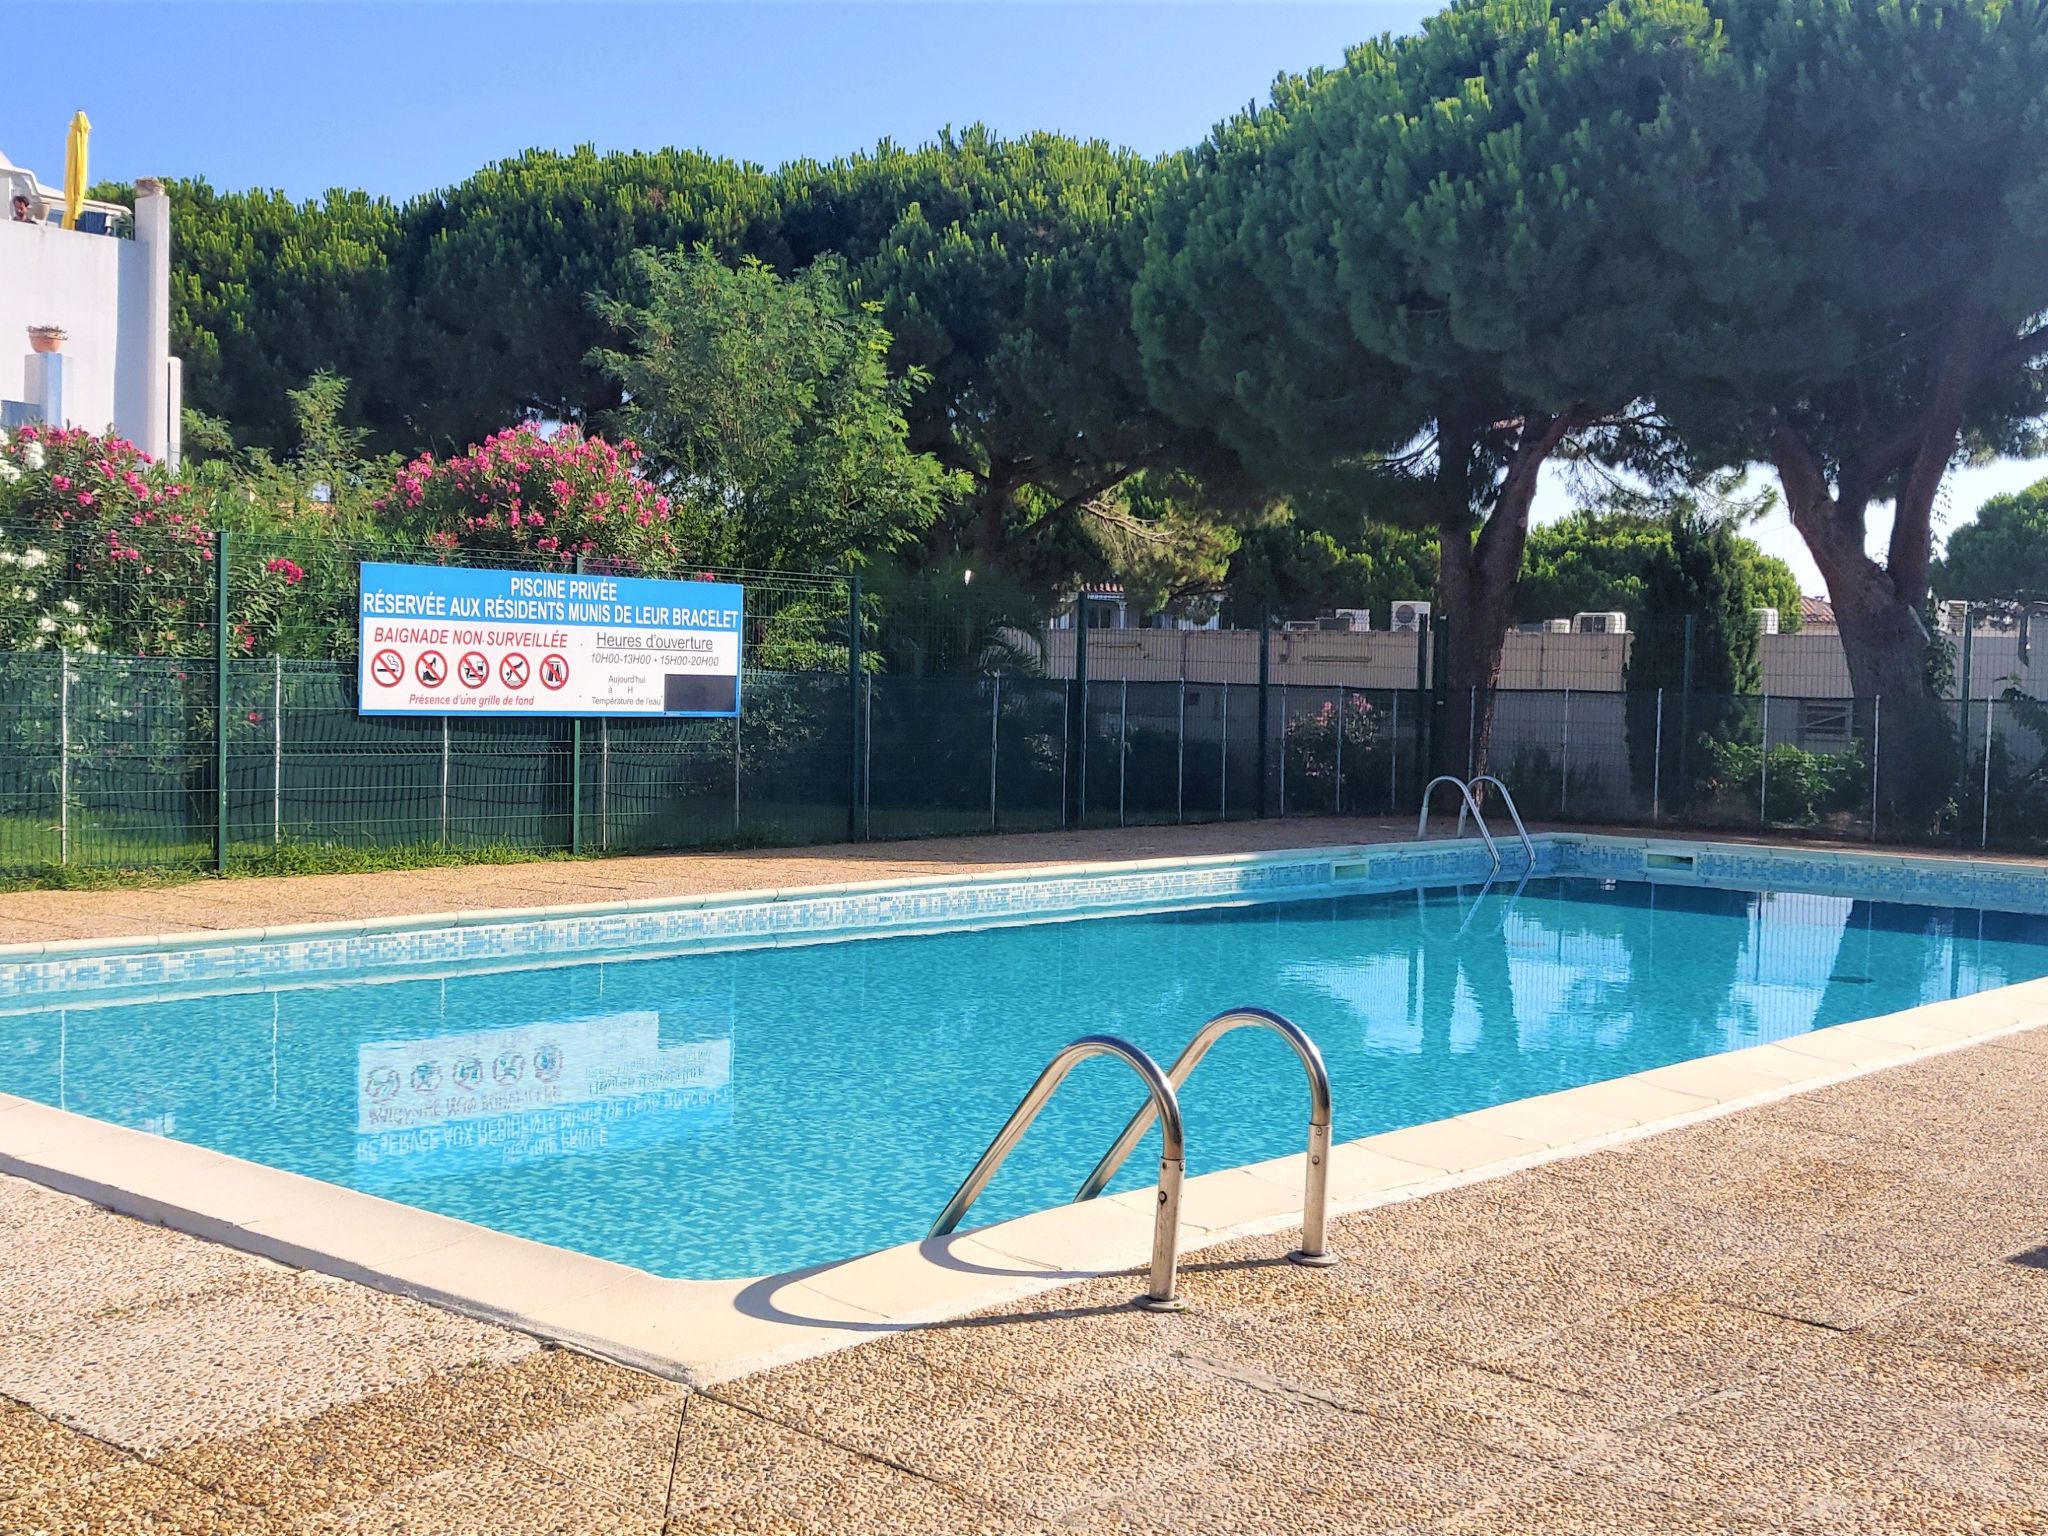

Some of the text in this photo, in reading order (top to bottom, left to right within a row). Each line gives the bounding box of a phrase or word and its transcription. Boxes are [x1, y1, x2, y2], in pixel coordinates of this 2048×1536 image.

[511, 577, 618, 601] PISCINE PRIVÉE
[363, 589, 739, 628] RÉSERVÉE AUX RÉSIDENTS MUNIS DE LEUR BRACELET
[374, 627, 568, 648] BAIGNADE NON SURVEILLÉE
[596, 632, 713, 650] Heures d'ouverture
[608, 675, 646, 685] Aujourd'hui
[627, 686, 634, 694] H
[408, 693, 535, 707] Présence d'une grille de fond
[592, 696, 662, 707] Température de l'eau
